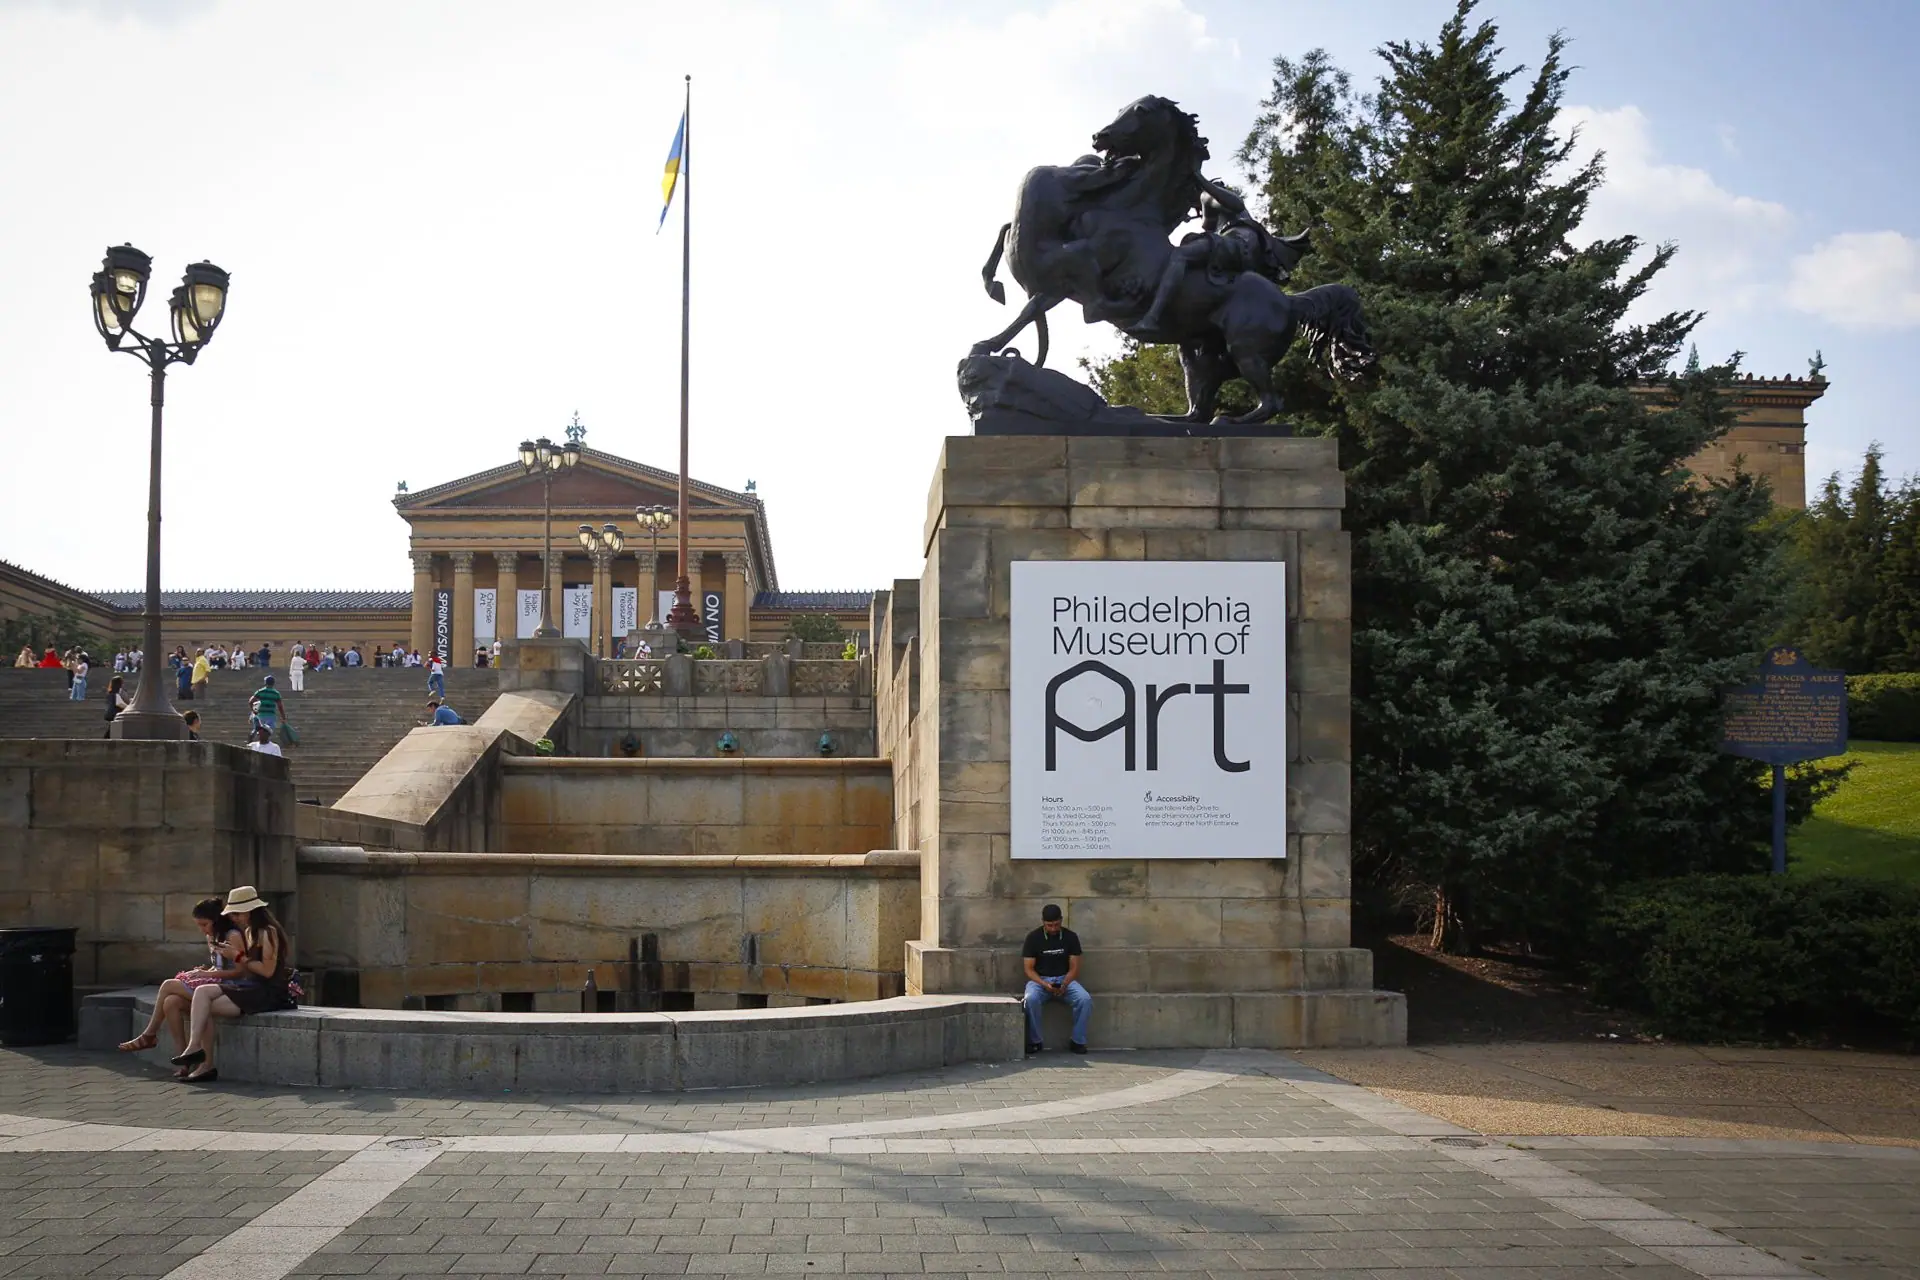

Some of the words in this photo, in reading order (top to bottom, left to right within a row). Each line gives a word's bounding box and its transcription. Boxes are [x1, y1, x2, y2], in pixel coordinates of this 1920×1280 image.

[486, 592, 494, 624] Chinese
[531, 593, 540, 613] Isaac
[573, 592, 581, 606] Joy
[581, 591, 589, 617] Judith
[626, 591, 635, 627] Medieval
[706, 594, 720, 622] ON
[1053, 595, 1250, 630] Philadelphia
[1053, 626, 1207, 656] Museum
[1214, 624, 1251, 656] of
[1045, 659, 1251, 773] Art
[1156, 795, 1200, 804] Accessibility
